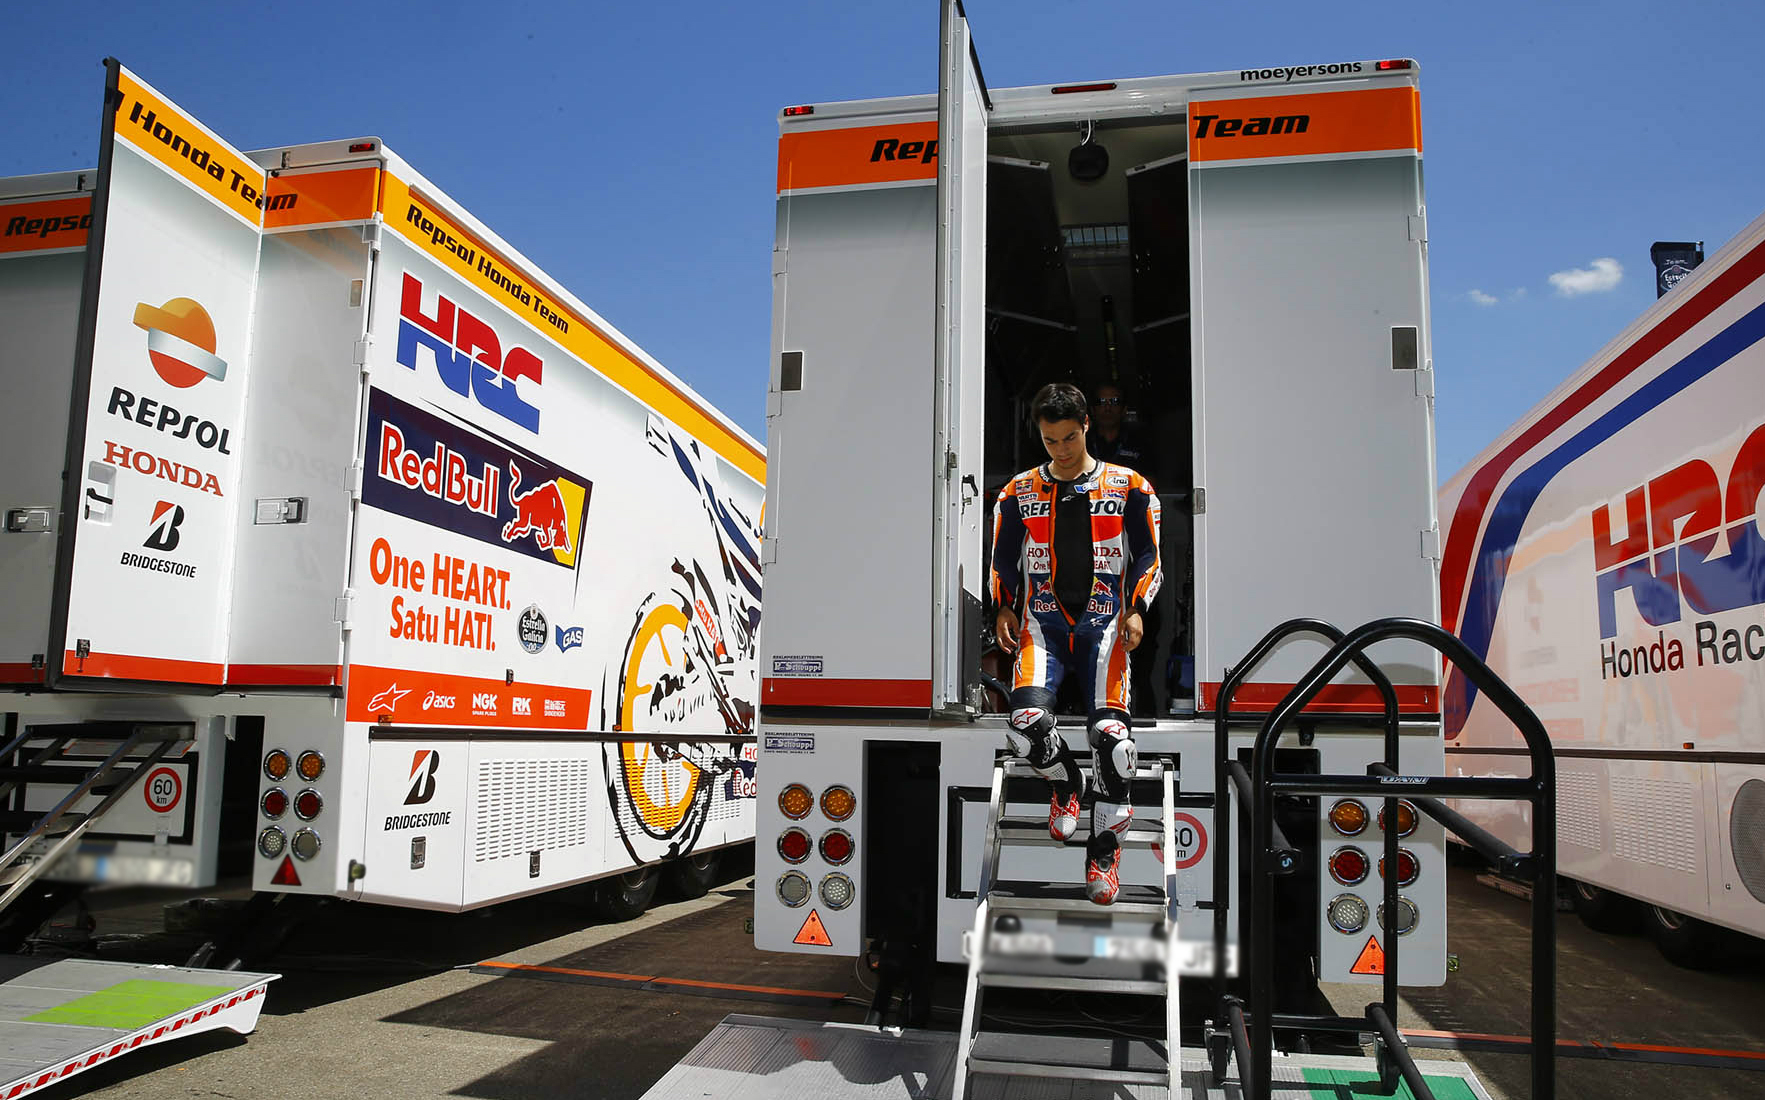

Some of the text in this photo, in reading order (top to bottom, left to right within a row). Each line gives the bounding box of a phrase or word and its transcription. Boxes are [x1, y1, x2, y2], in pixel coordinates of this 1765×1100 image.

[1241, 61, 1362, 84] moeyersons
[1193, 113, 1310, 140] Team
[129, 101, 298, 211] Honda Team
[870, 138, 938, 164] Rep
[5, 213, 93, 238] Repso
[407, 204, 570, 335] Repsol Honda Team
[396, 271, 544, 436] HRC
[107, 385, 231, 455] REPSOL
[102, 440, 225, 497] HONDA
[120, 551, 197, 579] BRIDGESTONE
[369, 537, 511, 611] One HEART.
[1087, 598, 1112, 615] Bull
[389, 595, 496, 652] Satu HATI.
[522, 615, 546, 632] Estrella
[562, 630, 583, 647] GAS
[1600, 631, 1685, 680] Honda
[433, 694, 457, 709] asics
[472, 693, 498, 711] NGK
[512, 697, 532, 713] RK
[153, 778, 173, 796] 60
[156, 795, 167, 804] km
[384, 810, 452, 831] BRIDGESTONE
[1175, 827, 1192, 847] 0
[1177, 849, 1186, 858] m
